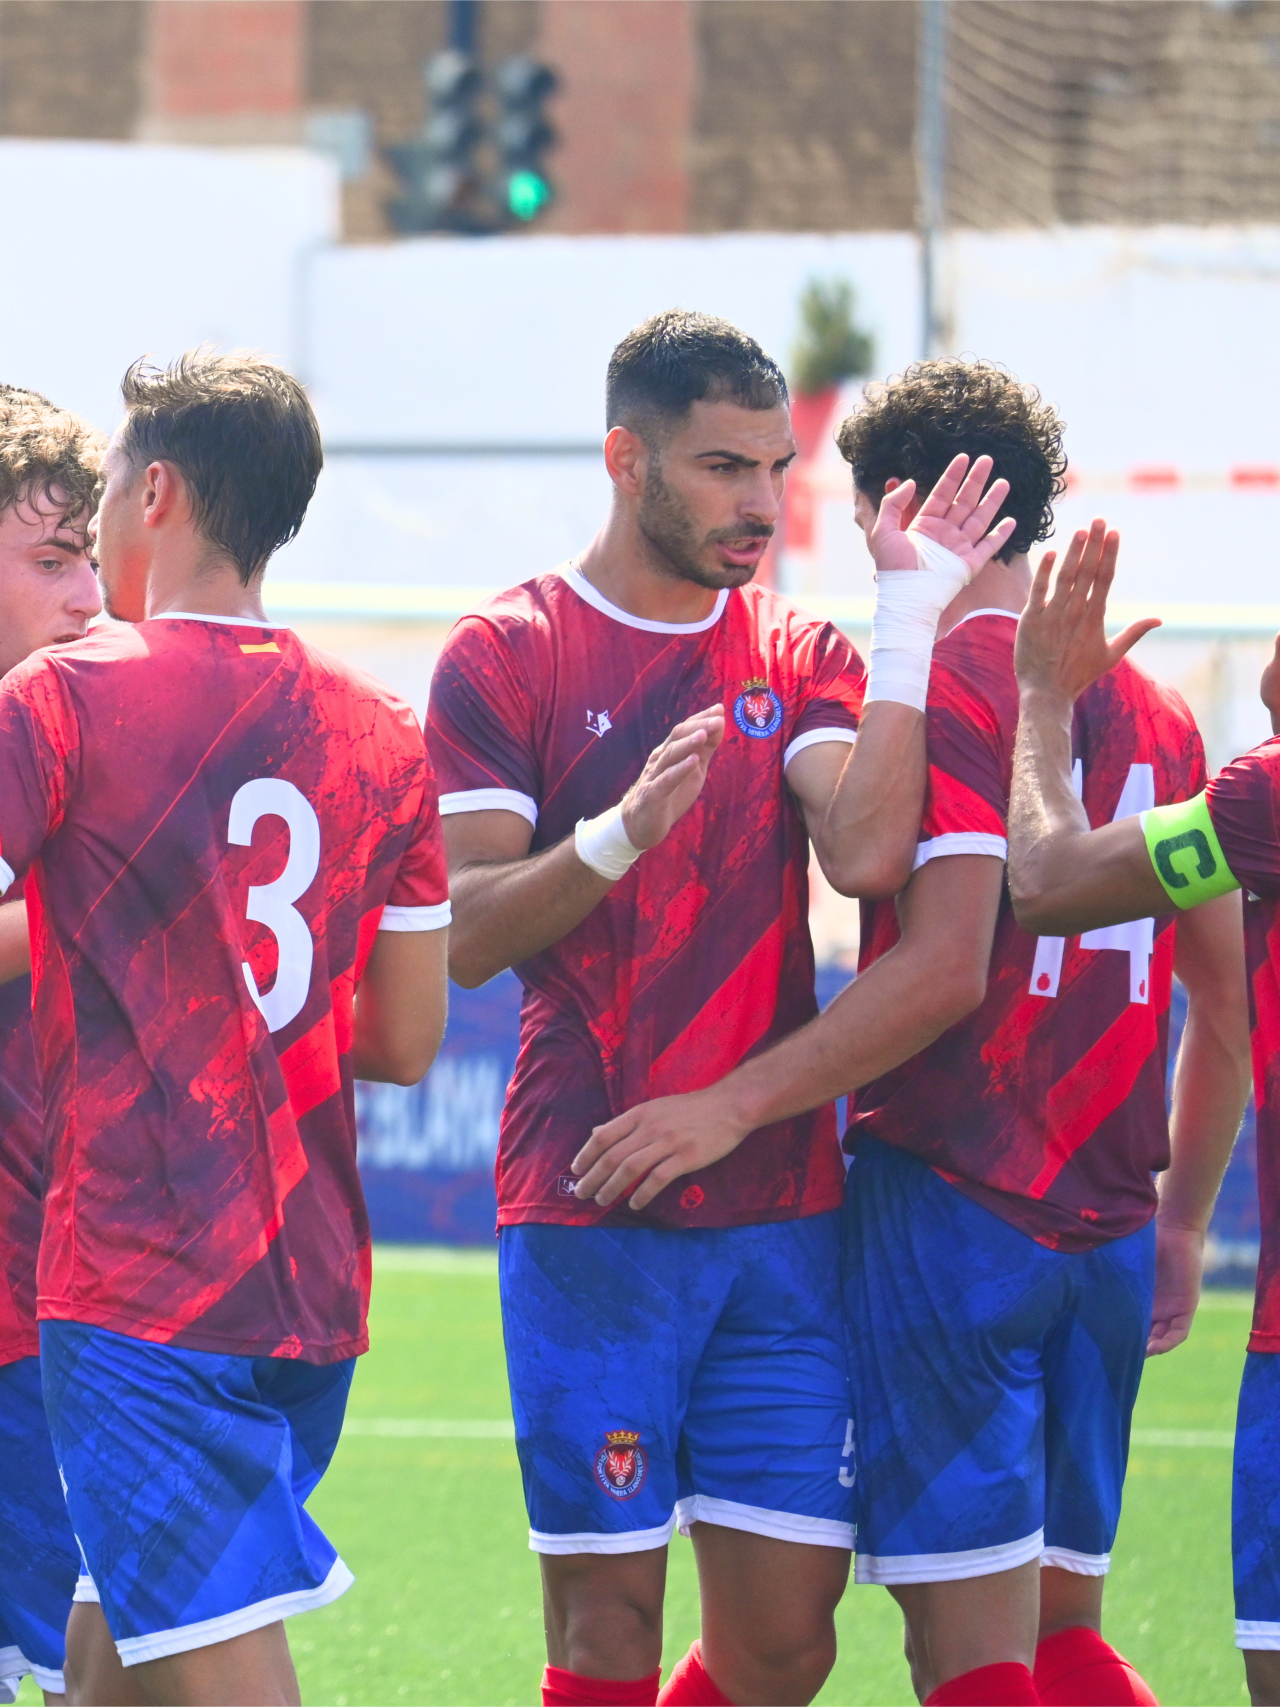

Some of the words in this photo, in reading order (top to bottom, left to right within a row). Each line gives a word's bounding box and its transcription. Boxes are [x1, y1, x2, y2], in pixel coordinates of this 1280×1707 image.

[1154, 829, 1217, 888] C
[227, 778, 320, 1033] 3
[596, 1454, 610, 1489] DEPORTIVA
[610, 1487, 628, 1497] MINERA
[627, 1477, 641, 1494] LLANO
